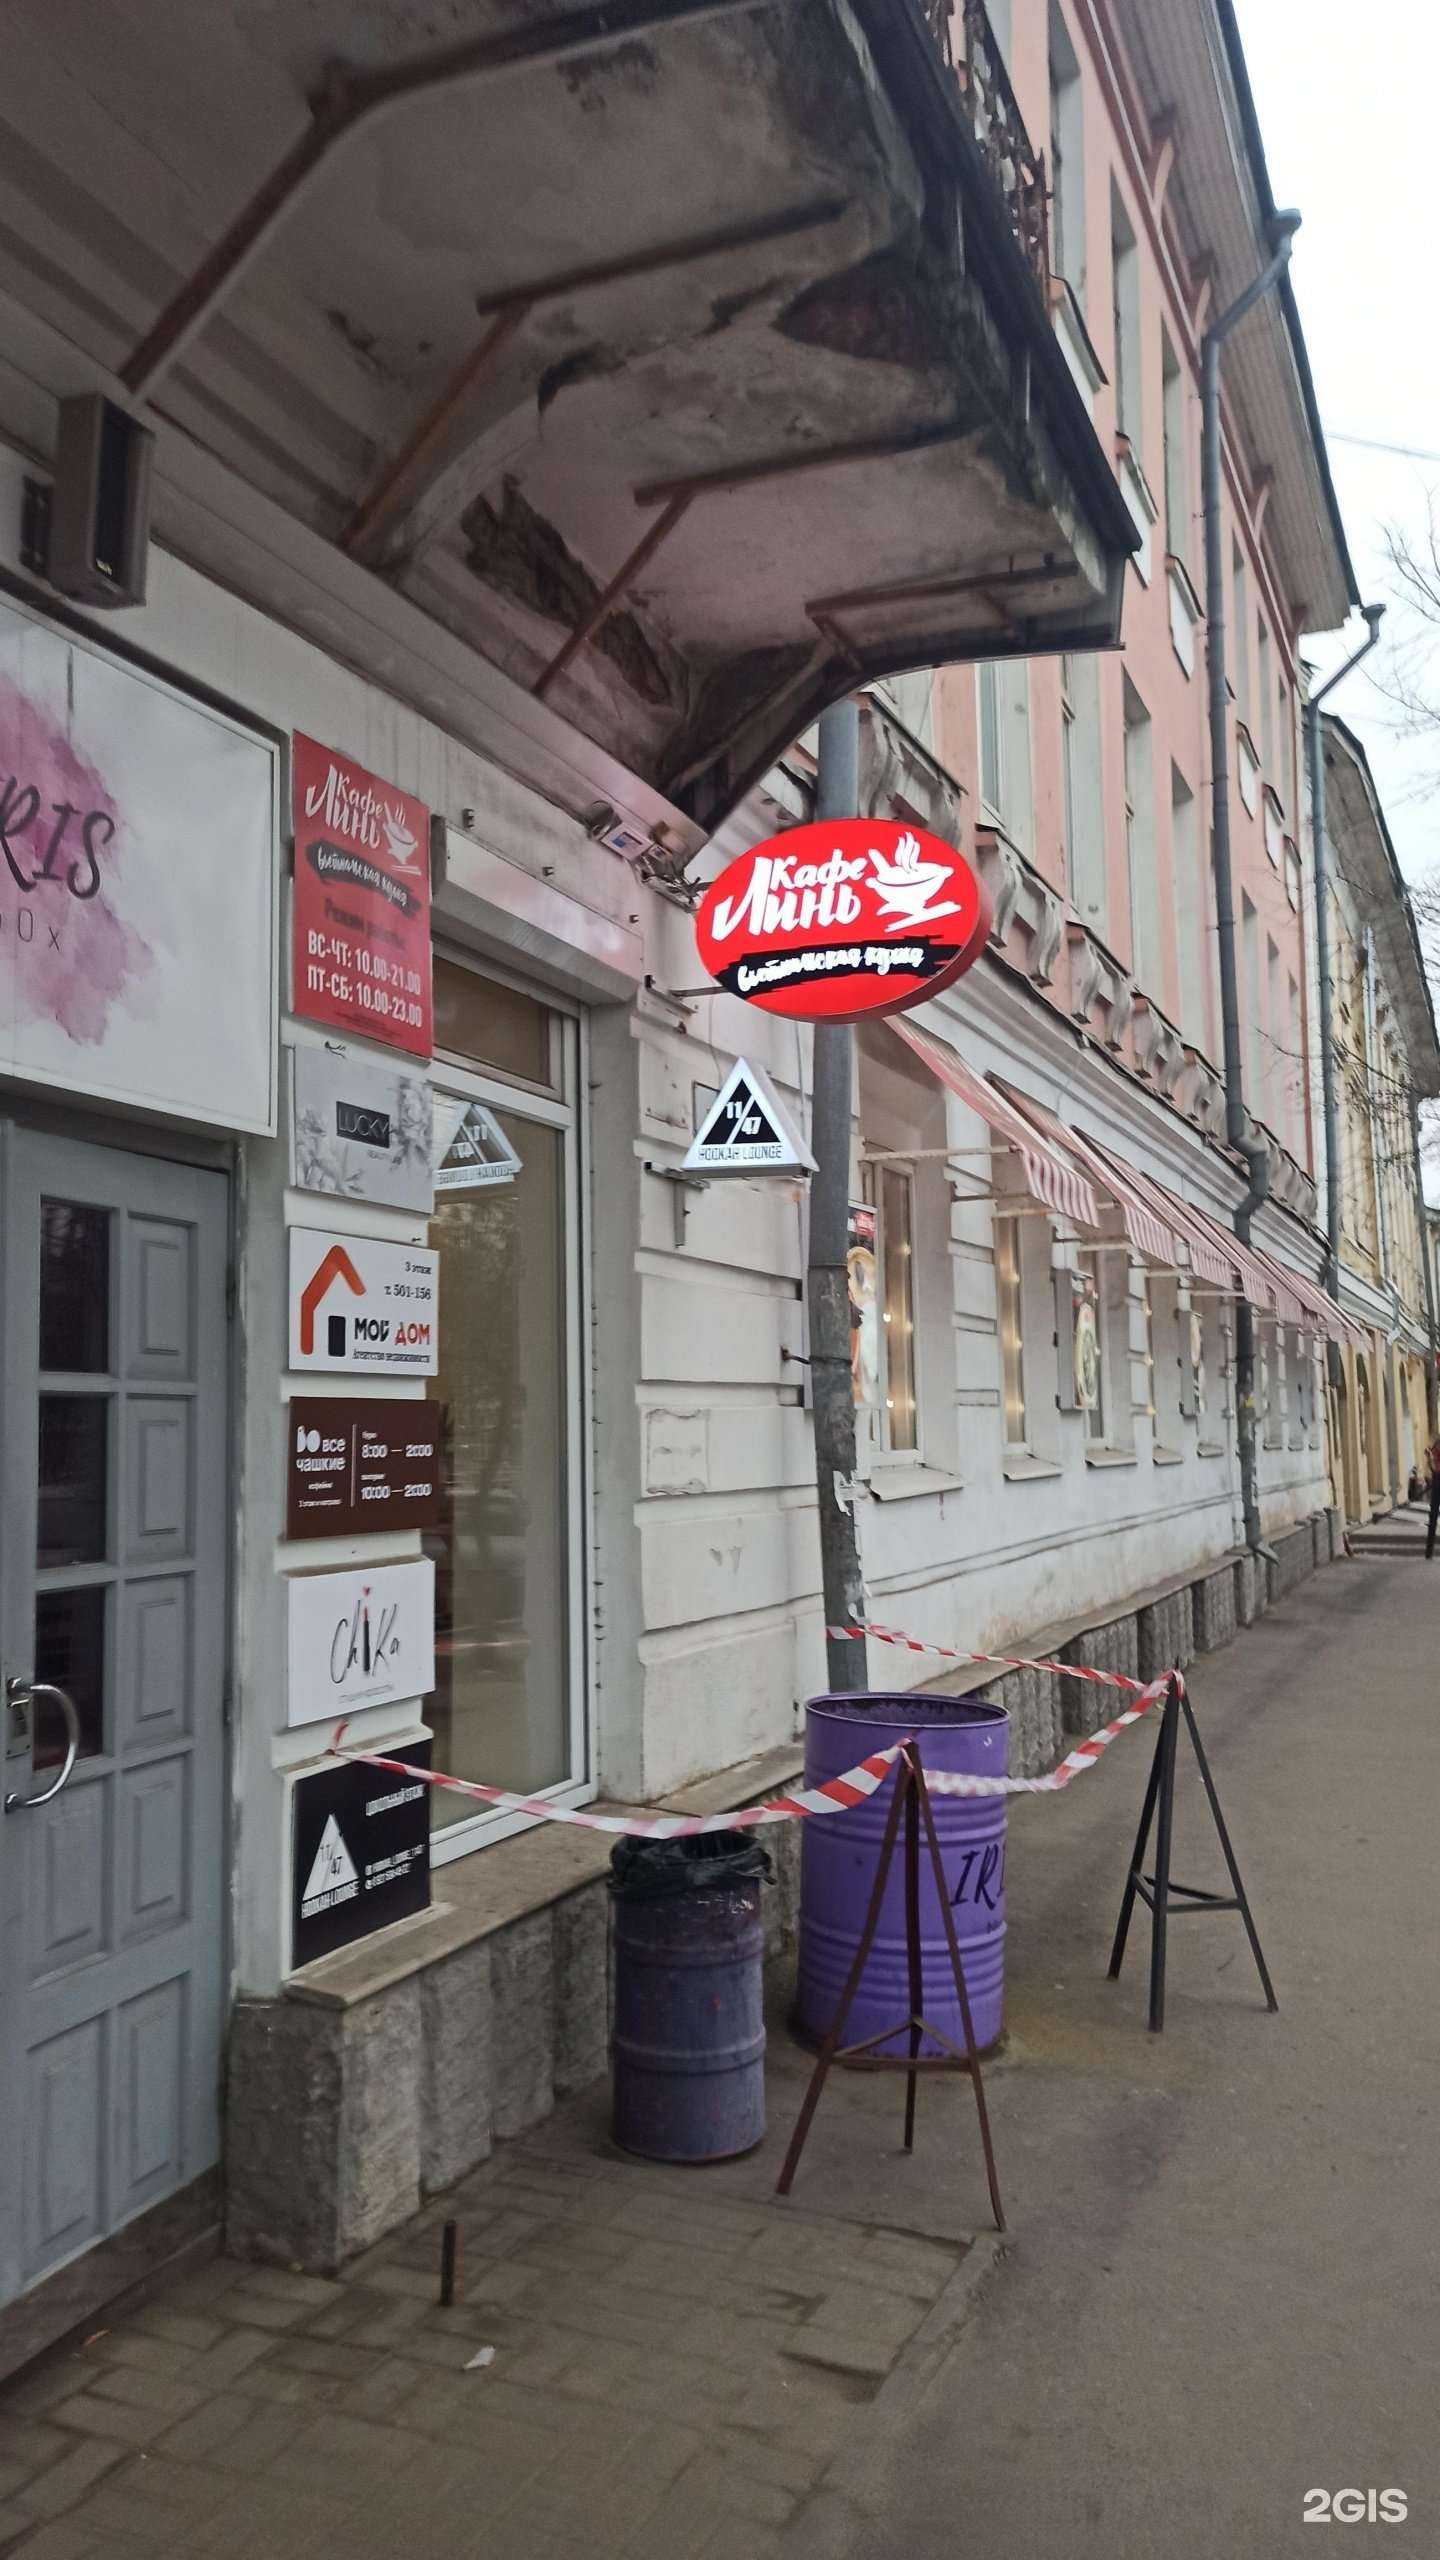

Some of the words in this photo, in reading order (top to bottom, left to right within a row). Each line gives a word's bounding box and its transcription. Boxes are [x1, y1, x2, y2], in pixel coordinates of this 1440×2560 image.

[305, 763, 380, 849] Линь
[338, 772, 384, 819] Кафе
[771, 849, 867, 890] Кафе
[711, 856, 861, 941] Линь
[308, 929, 352, 968] ВС-ЧТ:
[355, 948, 421, 995] 10.00-21.00
[307, 964, 353, 1002] ПТ-СБ:
[356, 981, 422, 1028] 10.00-23.00
[339, 1107, 389, 1140] LUCKY
[698, 1147, 738, 1160] HOOKAH
[743, 1145, 782, 1160] LOUNGE
[394, 1322, 431, 1346] ДОМ
[361, 1444, 388, 1458] 8:00
[361, 1485, 391, 1500] 10:00
